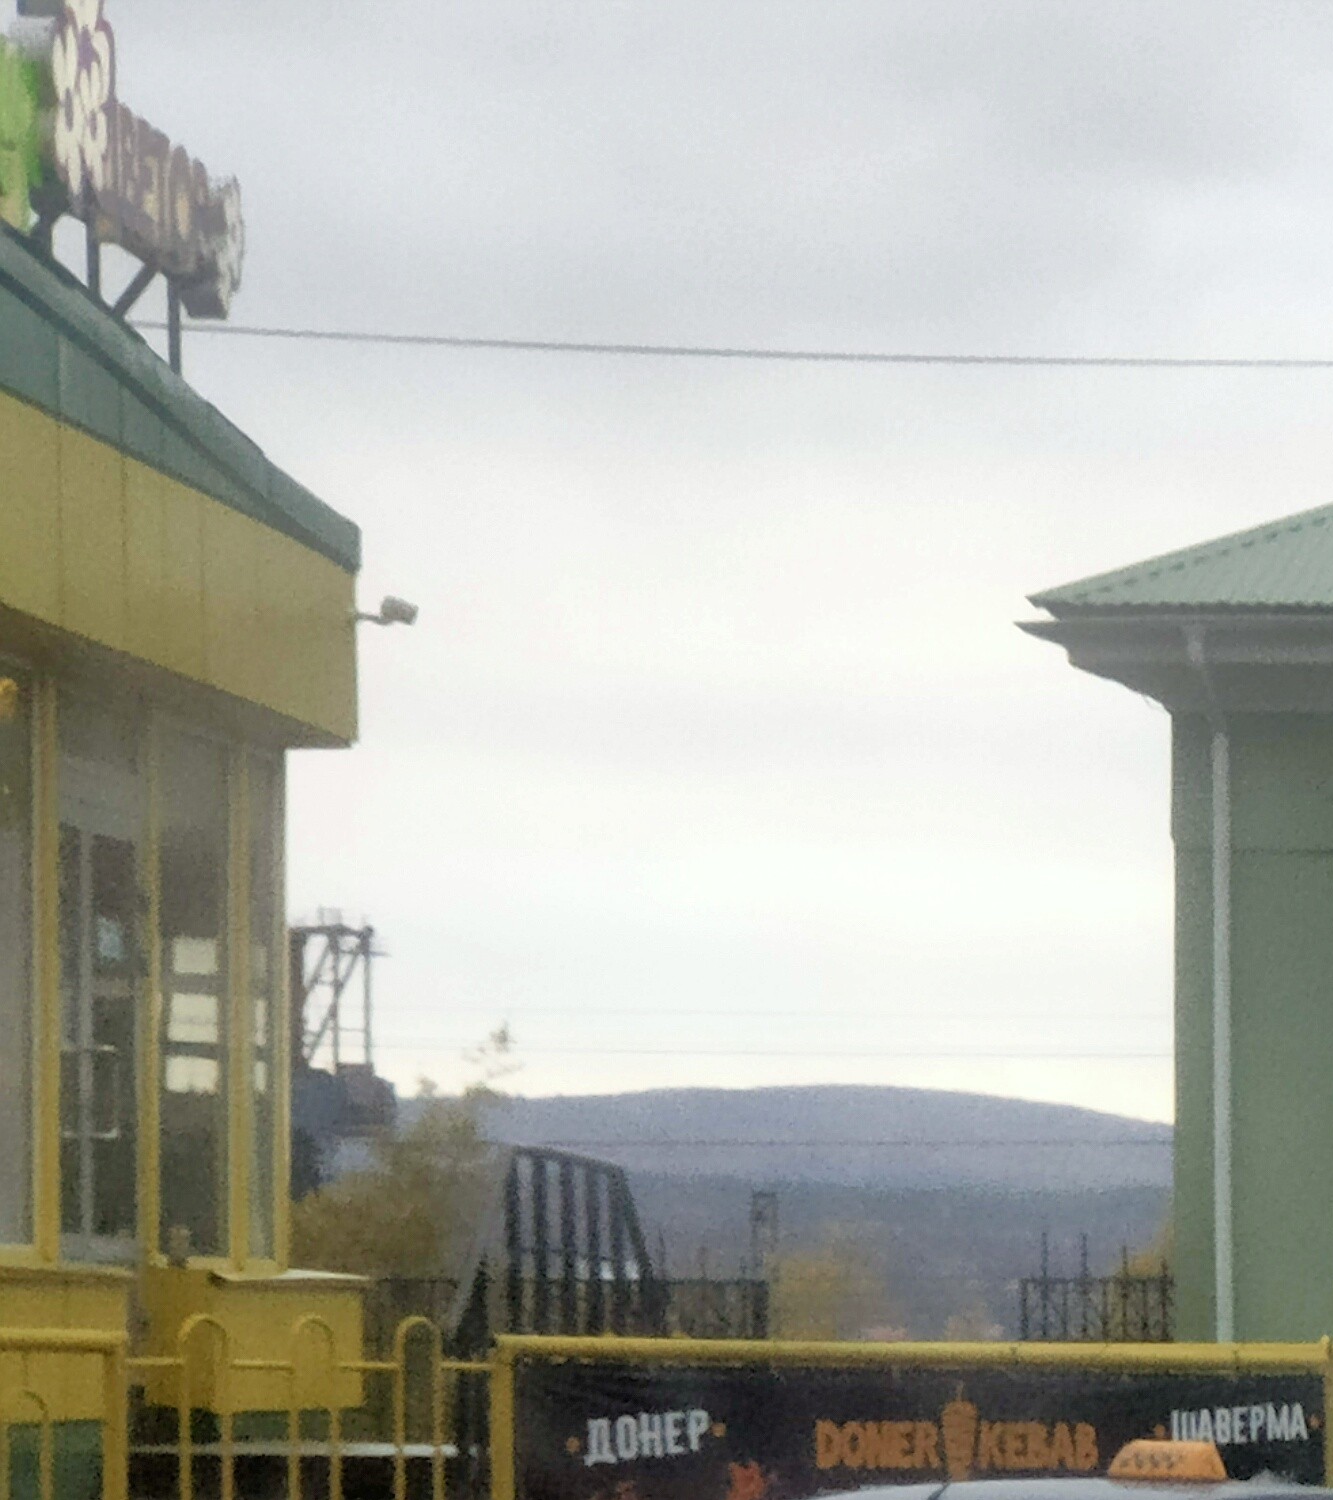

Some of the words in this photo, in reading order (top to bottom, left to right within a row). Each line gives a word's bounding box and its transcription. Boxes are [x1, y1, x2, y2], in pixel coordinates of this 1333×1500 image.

[583, 1408, 710, 1467] ДОНЕР
[814, 1418, 941, 1470] DONER
[980, 1420, 1099, 1471] KEBAB
[1170, 1401, 1309, 1444] ШАВЕРМА
